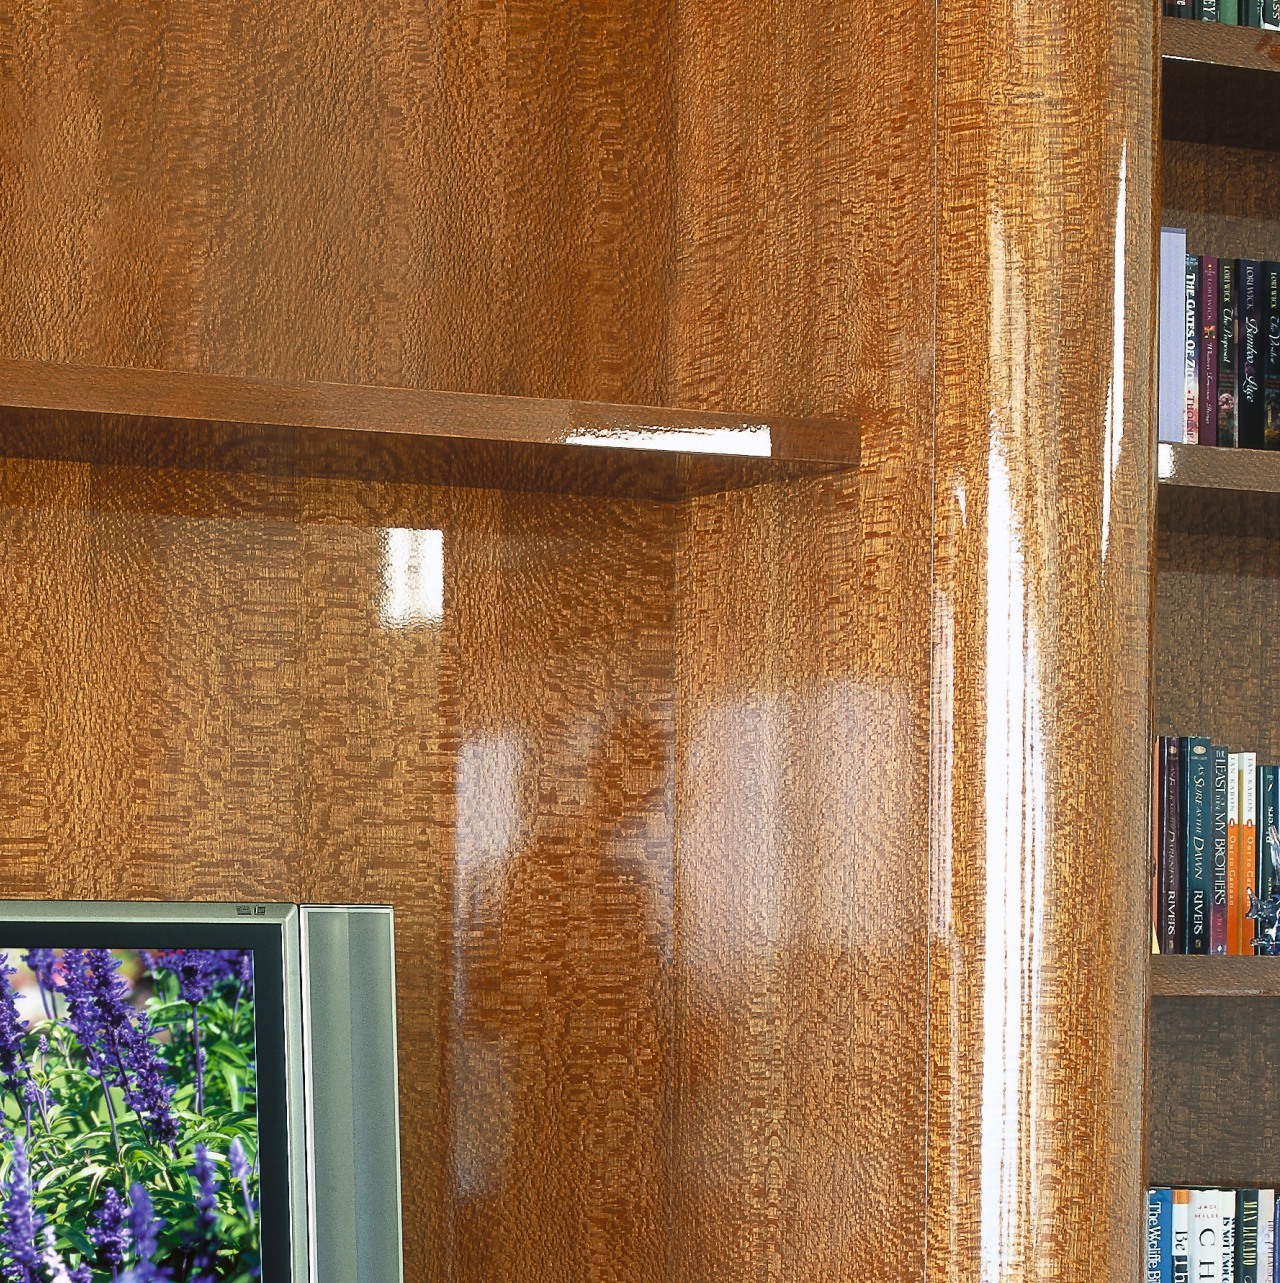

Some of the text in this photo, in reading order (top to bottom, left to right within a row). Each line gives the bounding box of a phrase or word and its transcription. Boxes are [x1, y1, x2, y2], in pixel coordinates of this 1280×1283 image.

[1186, 273, 1196, 296] THE
[1246, 266, 1254, 310] LORI WICK
[1186, 299, 1196, 337] GATES
[1186, 339, 1196, 358] OF
[1221, 308, 1234, 363] The Proposal
[1269, 316, 1280, 365] The Visitor
[1186, 359, 1196, 386] ZION
[1242, 317, 1258, 403] Bamboo Lace
[1198, 764, 1205, 776] AS
[1214, 759, 1226, 794] LEAST
[1193, 775, 1205, 806] SURF
[1196, 806, 1202, 817] AS
[1193, 836, 1205, 880] DAWN
[1214, 812, 1226, 905] MY BROTHERS
[1229, 858, 1236, 867] to
[1247, 858, 1253, 868] to
[1167, 890, 1176, 935] RIVERS
[1194, 890, 1204, 935] RIVERS
[1147, 1201, 1162, 1225] The
[1222, 1217, 1230, 1227] IS
[1175, 1230, 1189, 1251] Be
[1222, 1229, 1230, 1250] NOT
[1243, 1200, 1258, 1267] MAX LUCADO
